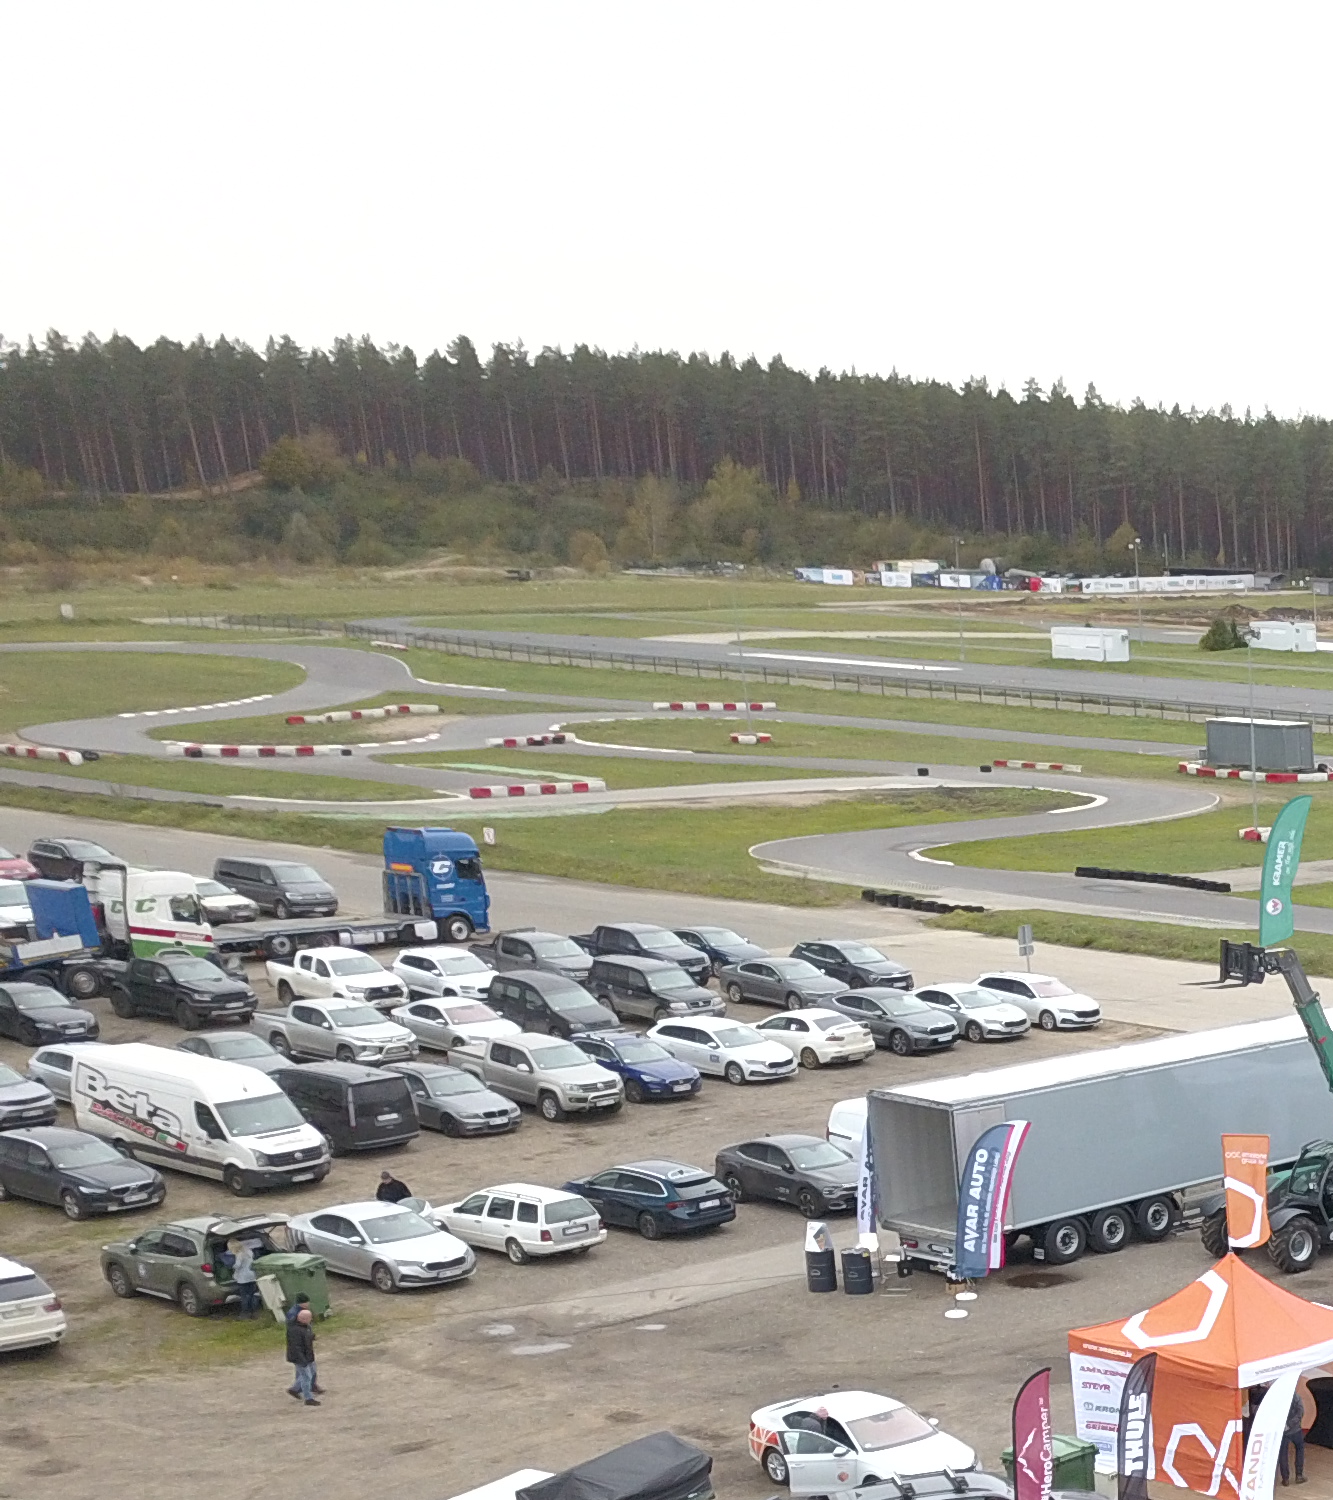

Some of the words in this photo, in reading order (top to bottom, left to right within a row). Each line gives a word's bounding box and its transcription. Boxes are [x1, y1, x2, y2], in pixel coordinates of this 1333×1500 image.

[1272, 840, 1289, 886] KRAMER
[74, 1062, 184, 1136] Beta
[91, 1101, 157, 1138] RACING
[969, 1148, 989, 1201] AUTO
[964, 1203, 979, 1253] AVAR
[1081, 1381, 1112, 1392] STEYR
[1123, 1392, 1148, 1478] THULE
